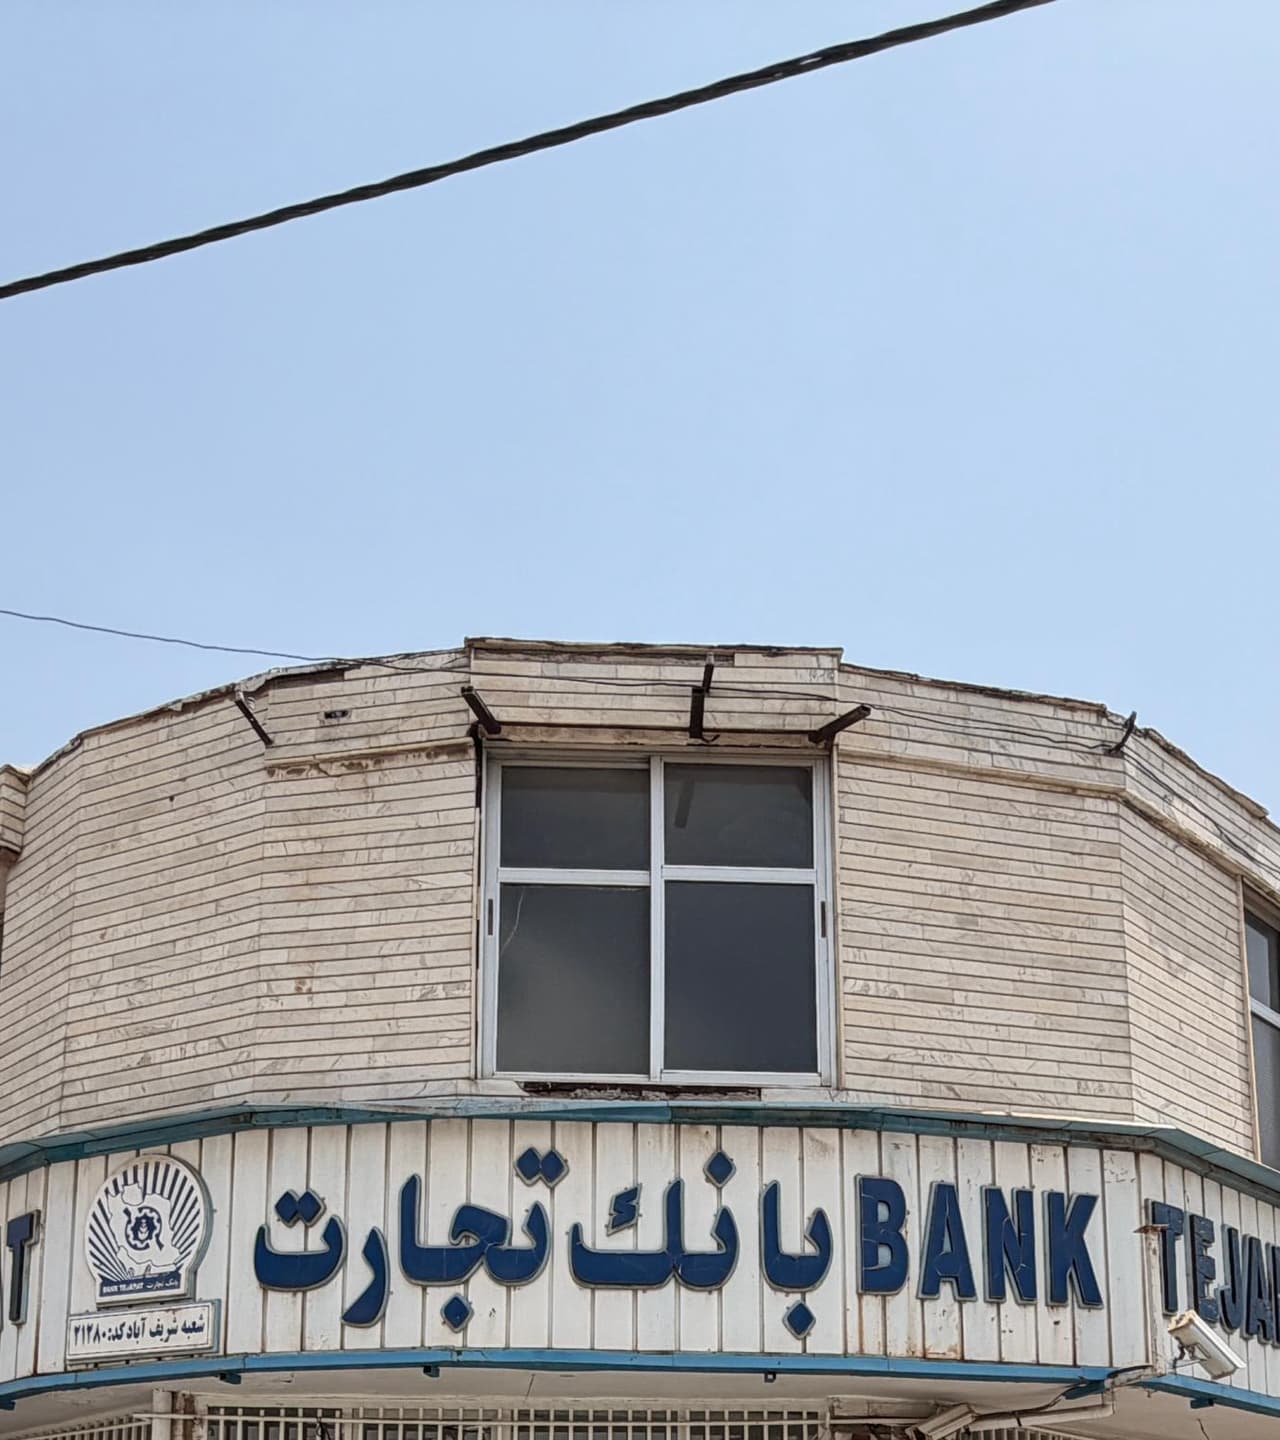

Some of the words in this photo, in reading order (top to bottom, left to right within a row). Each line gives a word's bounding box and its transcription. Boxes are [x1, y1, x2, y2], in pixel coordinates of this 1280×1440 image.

[254, 1147, 570, 1333] تجارت
[855, 1173, 1104, 1309] BANK
[149, 1317, 178, 1342] شریف
[181, 1313, 205, 1339] شعبه
